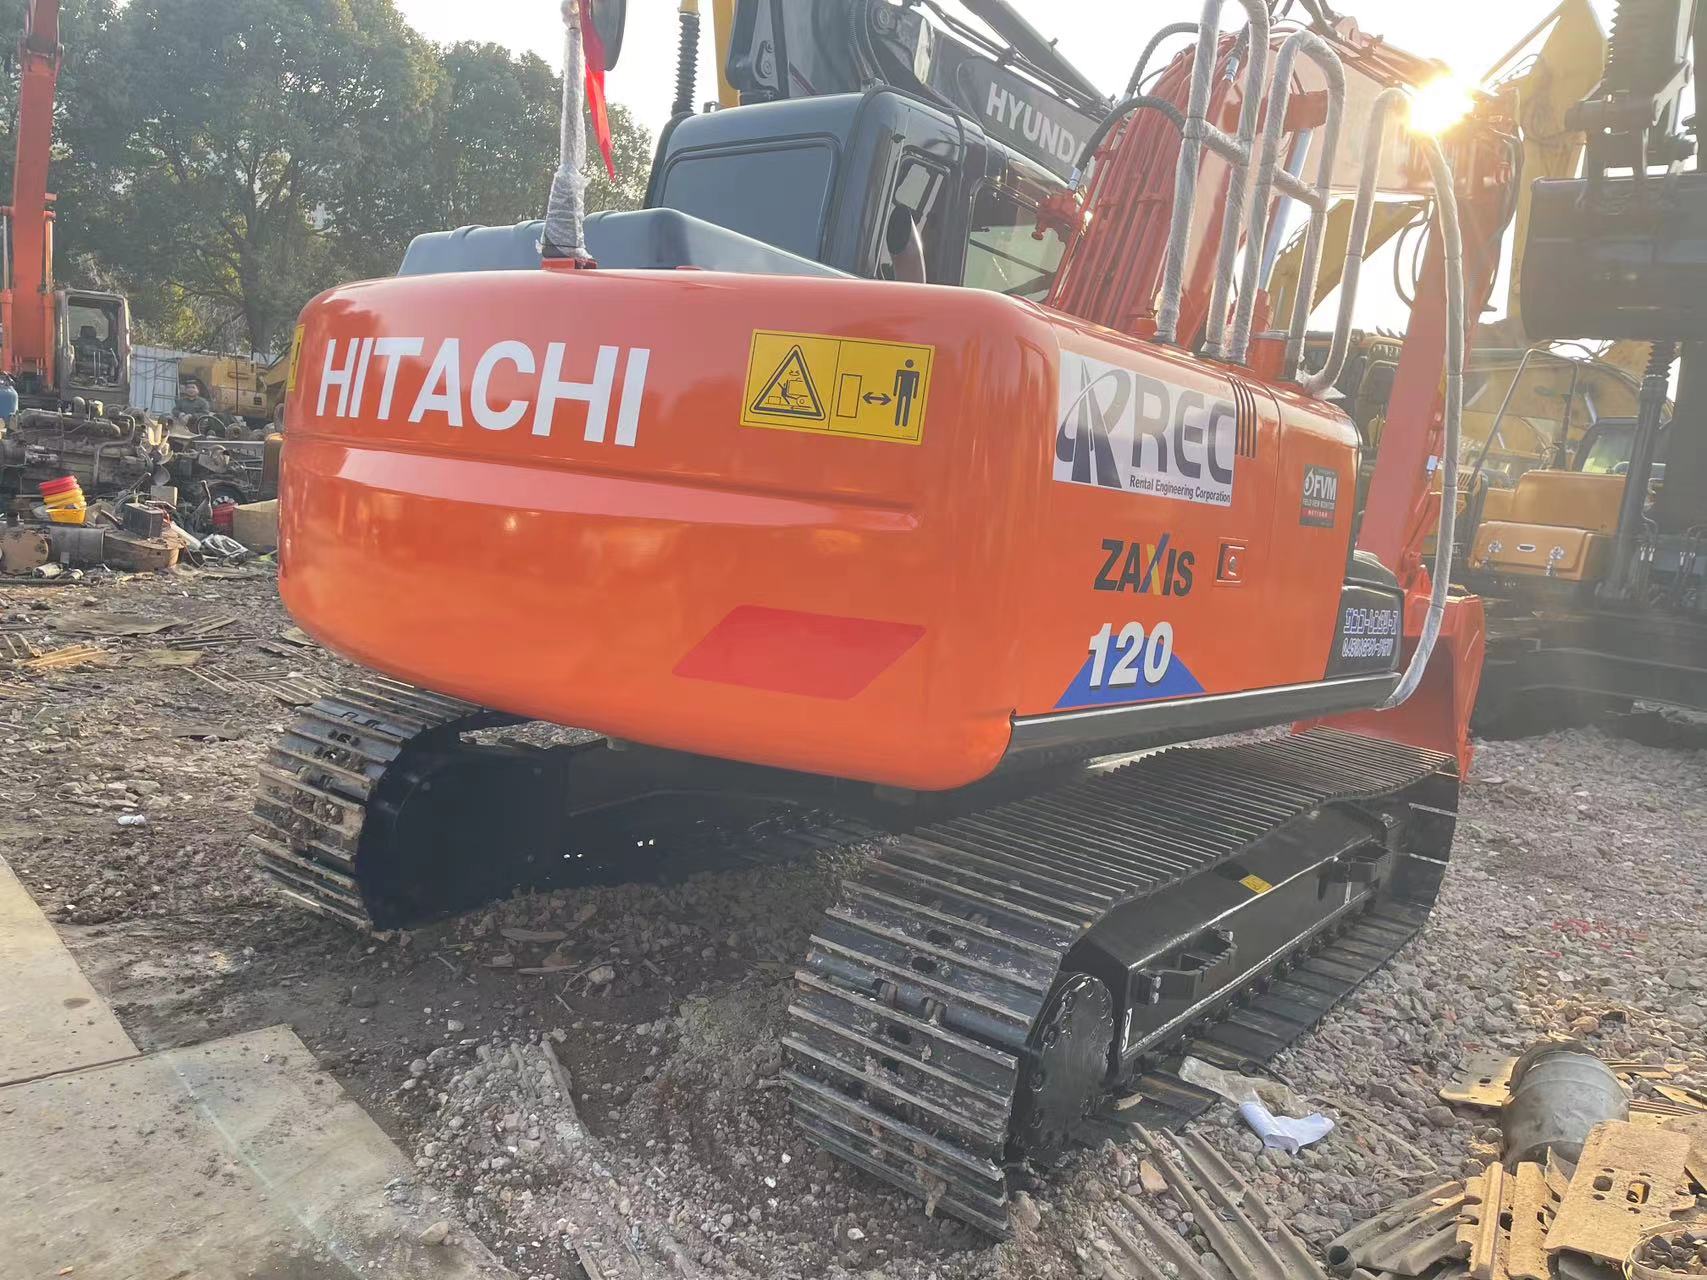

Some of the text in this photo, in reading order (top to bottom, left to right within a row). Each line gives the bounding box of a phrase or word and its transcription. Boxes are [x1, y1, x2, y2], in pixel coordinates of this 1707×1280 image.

[316, 336, 651, 447] HITACHI
[1131, 373, 1236, 485] REC
[1129, 474, 1231, 503] Rental Engineering Corporation
[1313, 474, 1337, 501] FVM
[1093, 532, 1196, 597] ZAXIS
[1088, 621, 1174, 688] 120
